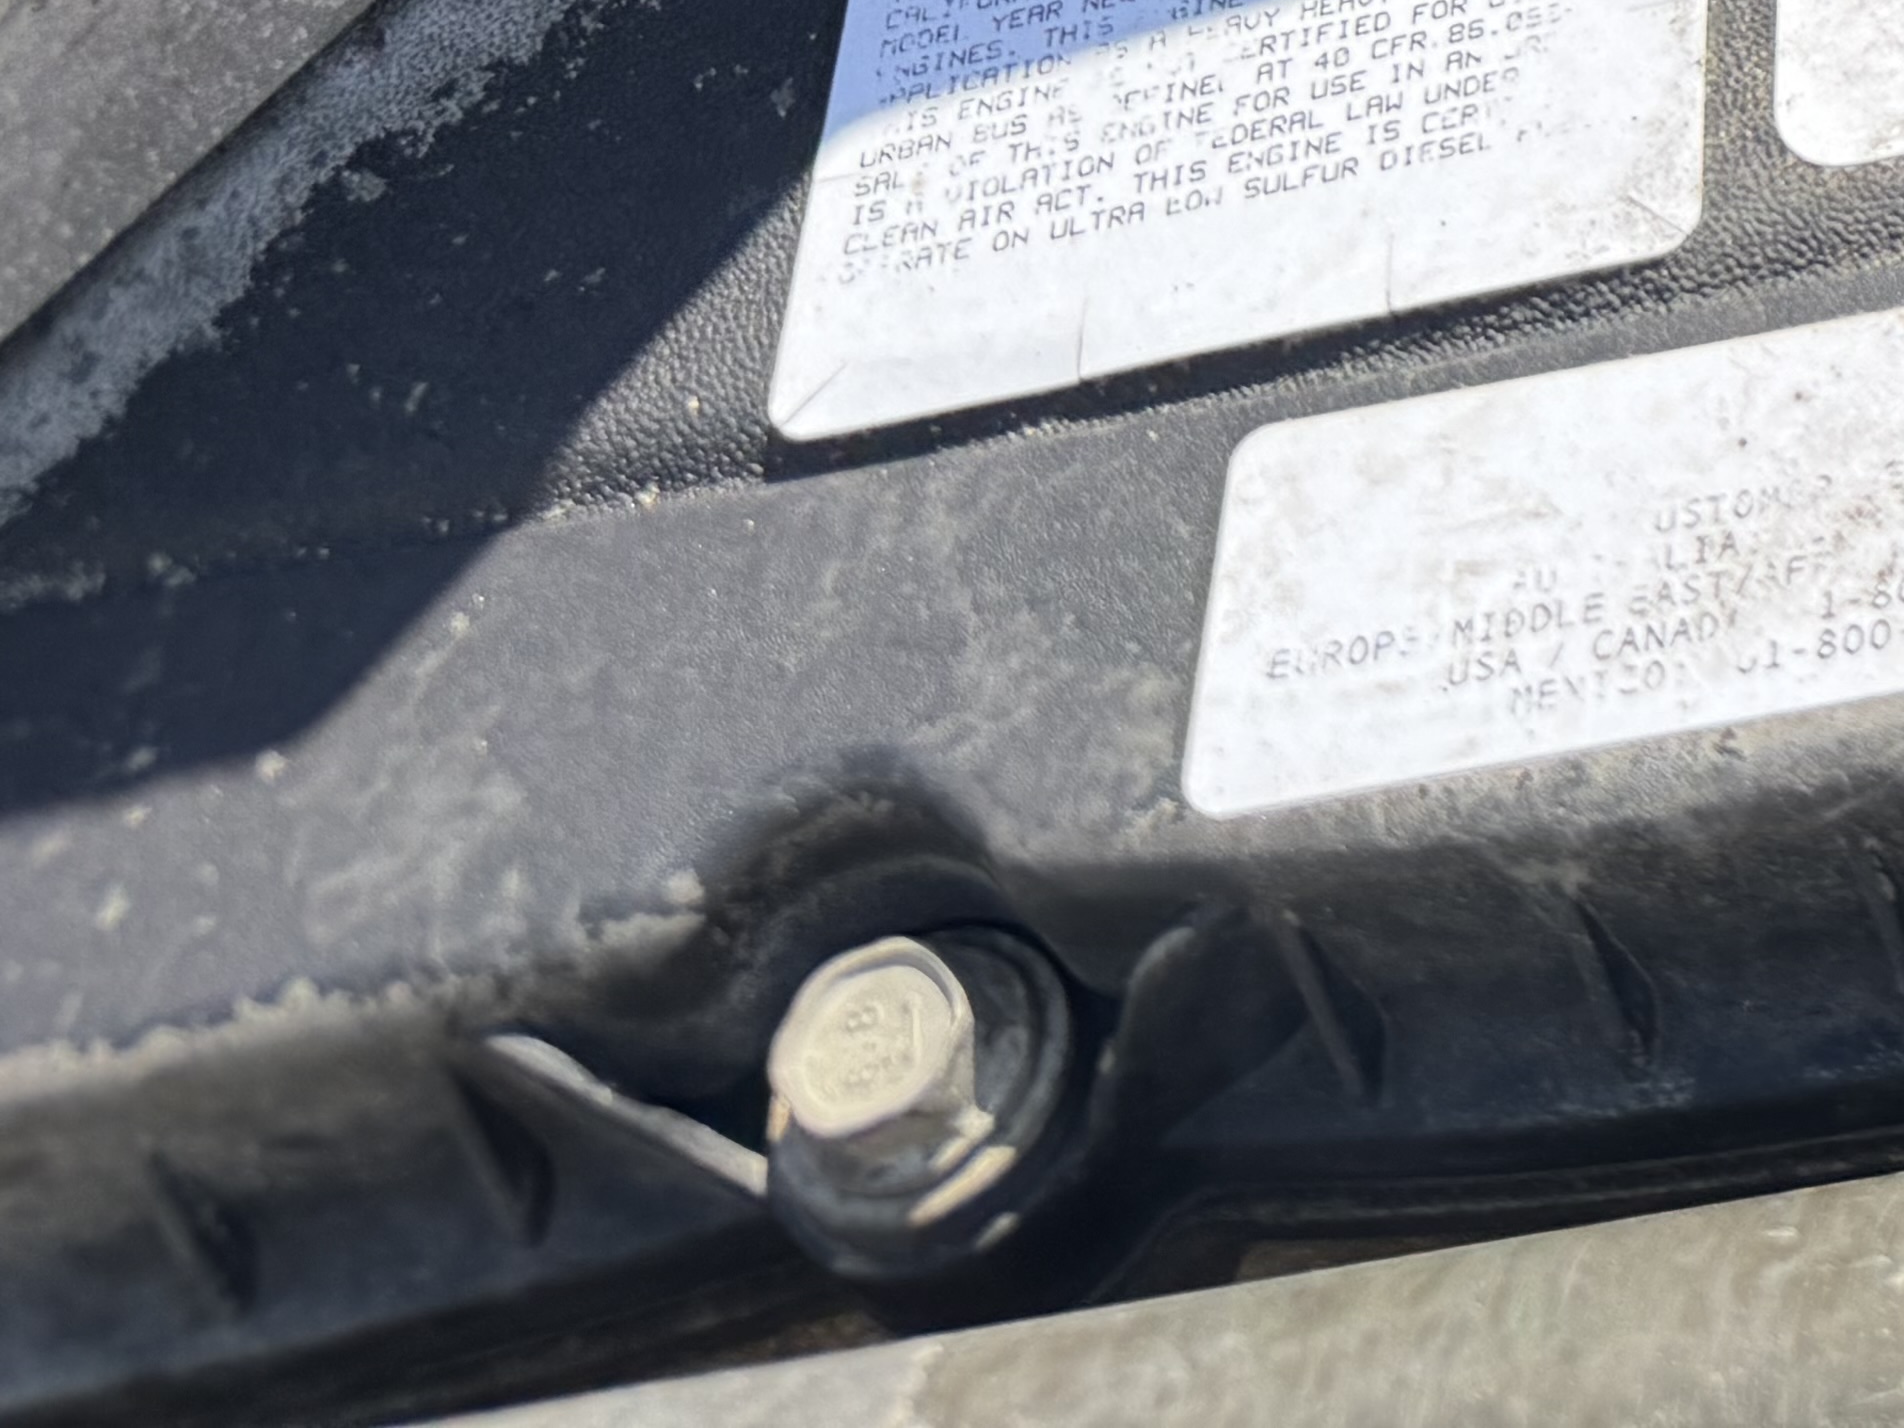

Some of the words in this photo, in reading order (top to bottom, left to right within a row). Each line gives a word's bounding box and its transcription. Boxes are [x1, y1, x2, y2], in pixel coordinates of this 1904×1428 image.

[875, 35, 1018, 83] NGINES.
[1041, 14, 1115, 48] THIS
[990, 0, 1064, 33] YEAR
[1228, 10, 1391, 62] ERTIFIED
[859, 129, 952, 168] URBAN
[1256, 58, 1292, 84] AT
[1233, 85, 1290, 117] FOR
[1309, 69, 1367, 101] USE
[1391, 57, 1425, 84] IN
[1445, 44, 1483, 72] AN
[843, 216, 938, 255] CLEAN
[957, 199, 1016, 231] AIR
[1033, 180, 1105, 215] ACT.
[1132, 159, 1207, 194] THIS
[1227, 131, 1342, 174] ENGINE
[1366, 118, 1400, 145] IS
[851, 199, 887, 226] IS
[1344, 90, 1403, 122] LAW
[991, 225, 1029, 252] ON
[1048, 201, 1146, 240] ULTRA
[1242, 156, 1359, 199] SULFUR
[1447, 645, 1523, 687] USA
